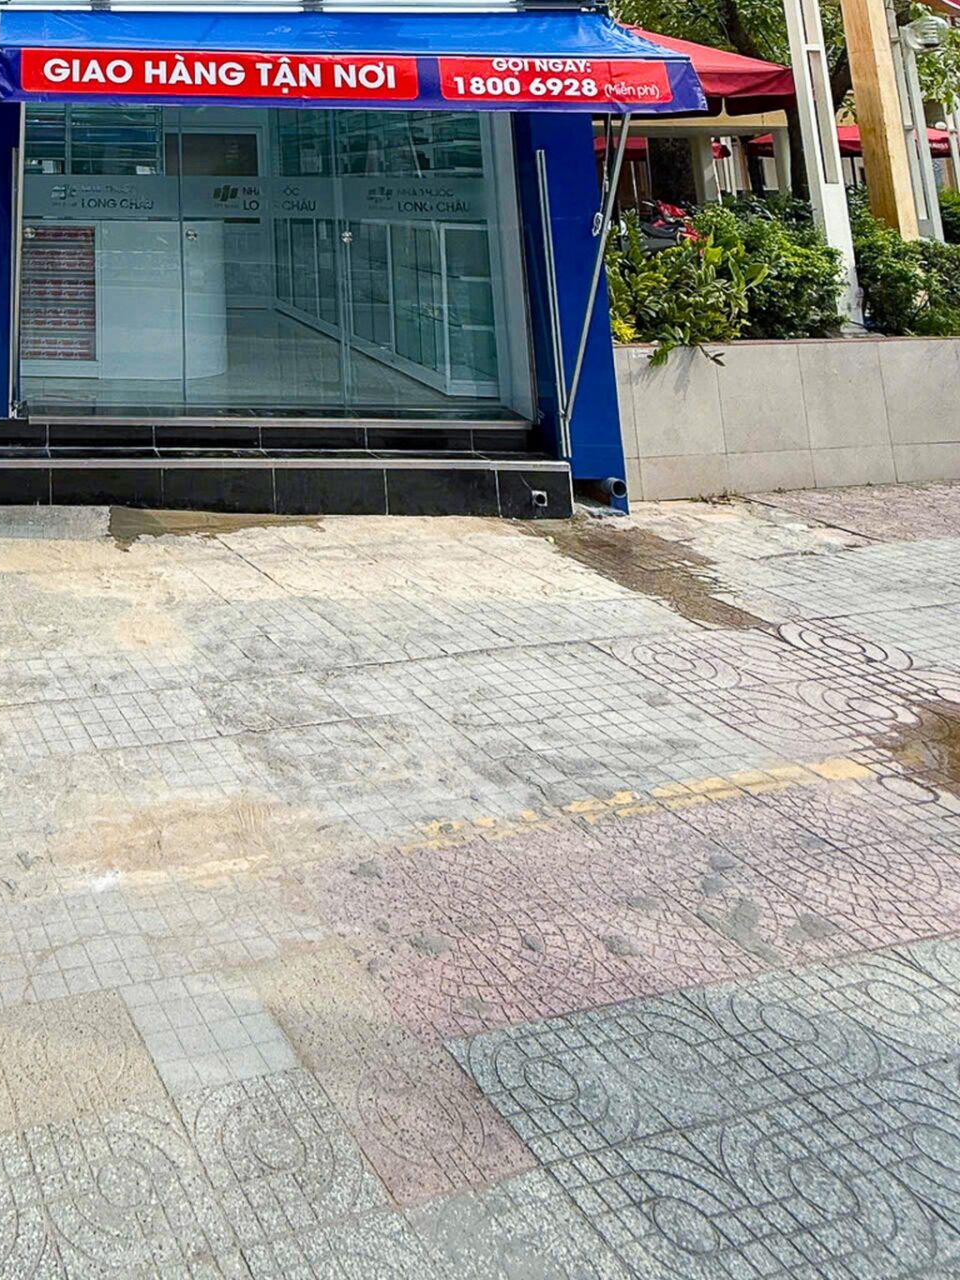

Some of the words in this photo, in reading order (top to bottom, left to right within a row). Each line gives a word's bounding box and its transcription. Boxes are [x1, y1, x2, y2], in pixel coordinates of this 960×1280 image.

[43, 57, 133, 83] GIAO
[144, 53, 246, 86] HÀNG
[256, 56, 321, 93] TẬN
[334, 62, 396, 88] NƠI
[492, 58, 529, 75] GỌI
[534, 58, 591, 73] NGAY:
[453, 76, 520, 95] 1800
[529, 76, 598, 97] 6928
[604, 80, 636, 98] (Miễn
[636, 83, 660, 99] phí)
